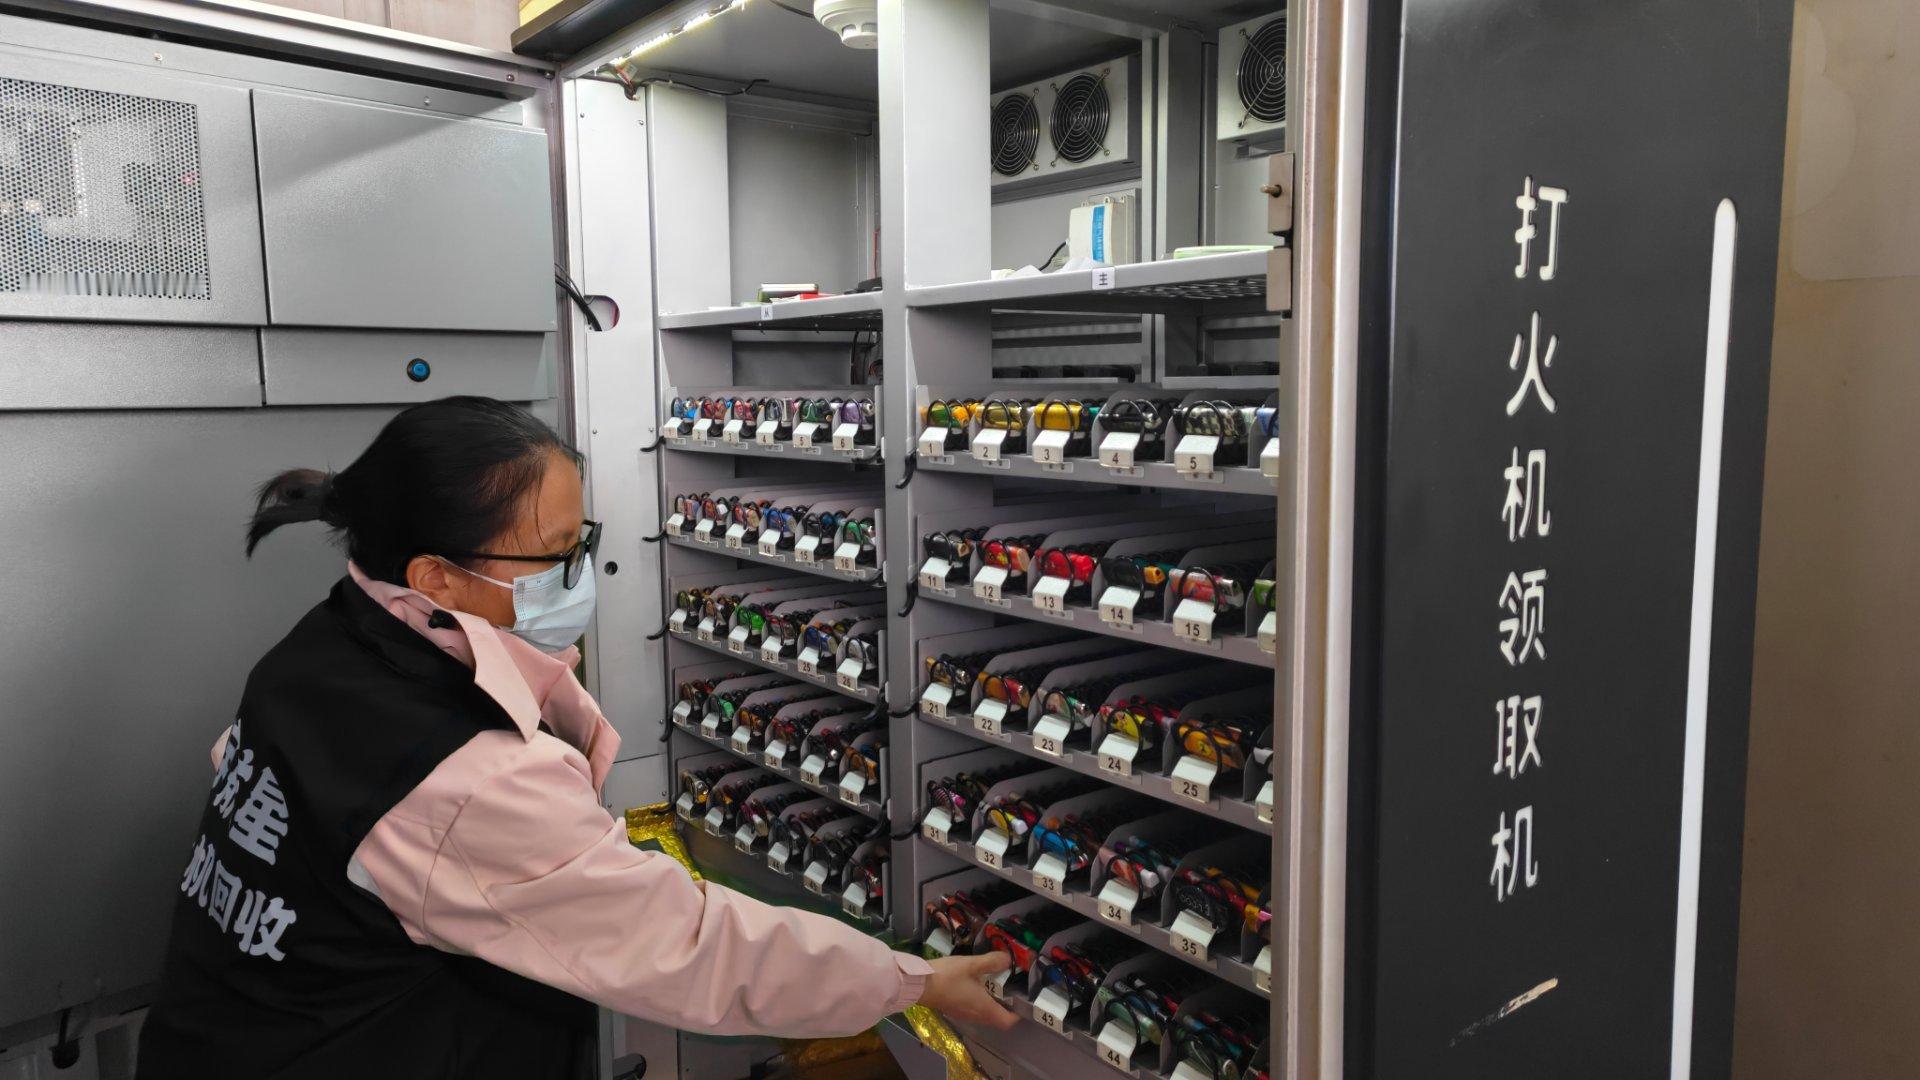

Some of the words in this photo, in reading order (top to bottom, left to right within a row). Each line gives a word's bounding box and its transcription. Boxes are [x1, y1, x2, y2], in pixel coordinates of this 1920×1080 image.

[799, 436, 804, 446] 5
[840, 438, 845, 448] 6
[929, 442, 933, 454] 1
[983, 446, 989, 458] 2
[1043, 448, 1050, 461] 3
[1112, 452, 1119, 465] 4
[1190, 456, 1197, 470] 5
[729, 538, 737, 547] 13
[1490, 176, 1568, 902] 打火机领取机
[763, 545, 771, 554] 14
[800, 550, 808, 560] 15
[841, 558, 850, 568] 16
[927, 575, 937, 587] 11
[983, 585, 994, 599] 12
[1043, 596, 1055, 609] 13
[1110, 607, 1124, 621] 14
[1185, 622, 1200, 637] 15
[803, 661, 811, 672] 25
[929, 702, 939, 714] 21
[981, 718, 993, 731] 22
[1041, 738, 1054, 752] 23
[1108, 756, 1122, 772] 24
[1183, 781, 1198, 798] 25
[930, 826, 939, 840] 31
[984, 851, 995, 865] 32
[1042, 877, 1054, 891] 33
[1108, 905, 1122, 921] 34
[1182, 938, 1197, 955] 35
[984, 979, 996, 994] 42
[1041, 1012, 1054, 1027] 43
[1107, 1050, 1121, 1066] 44
